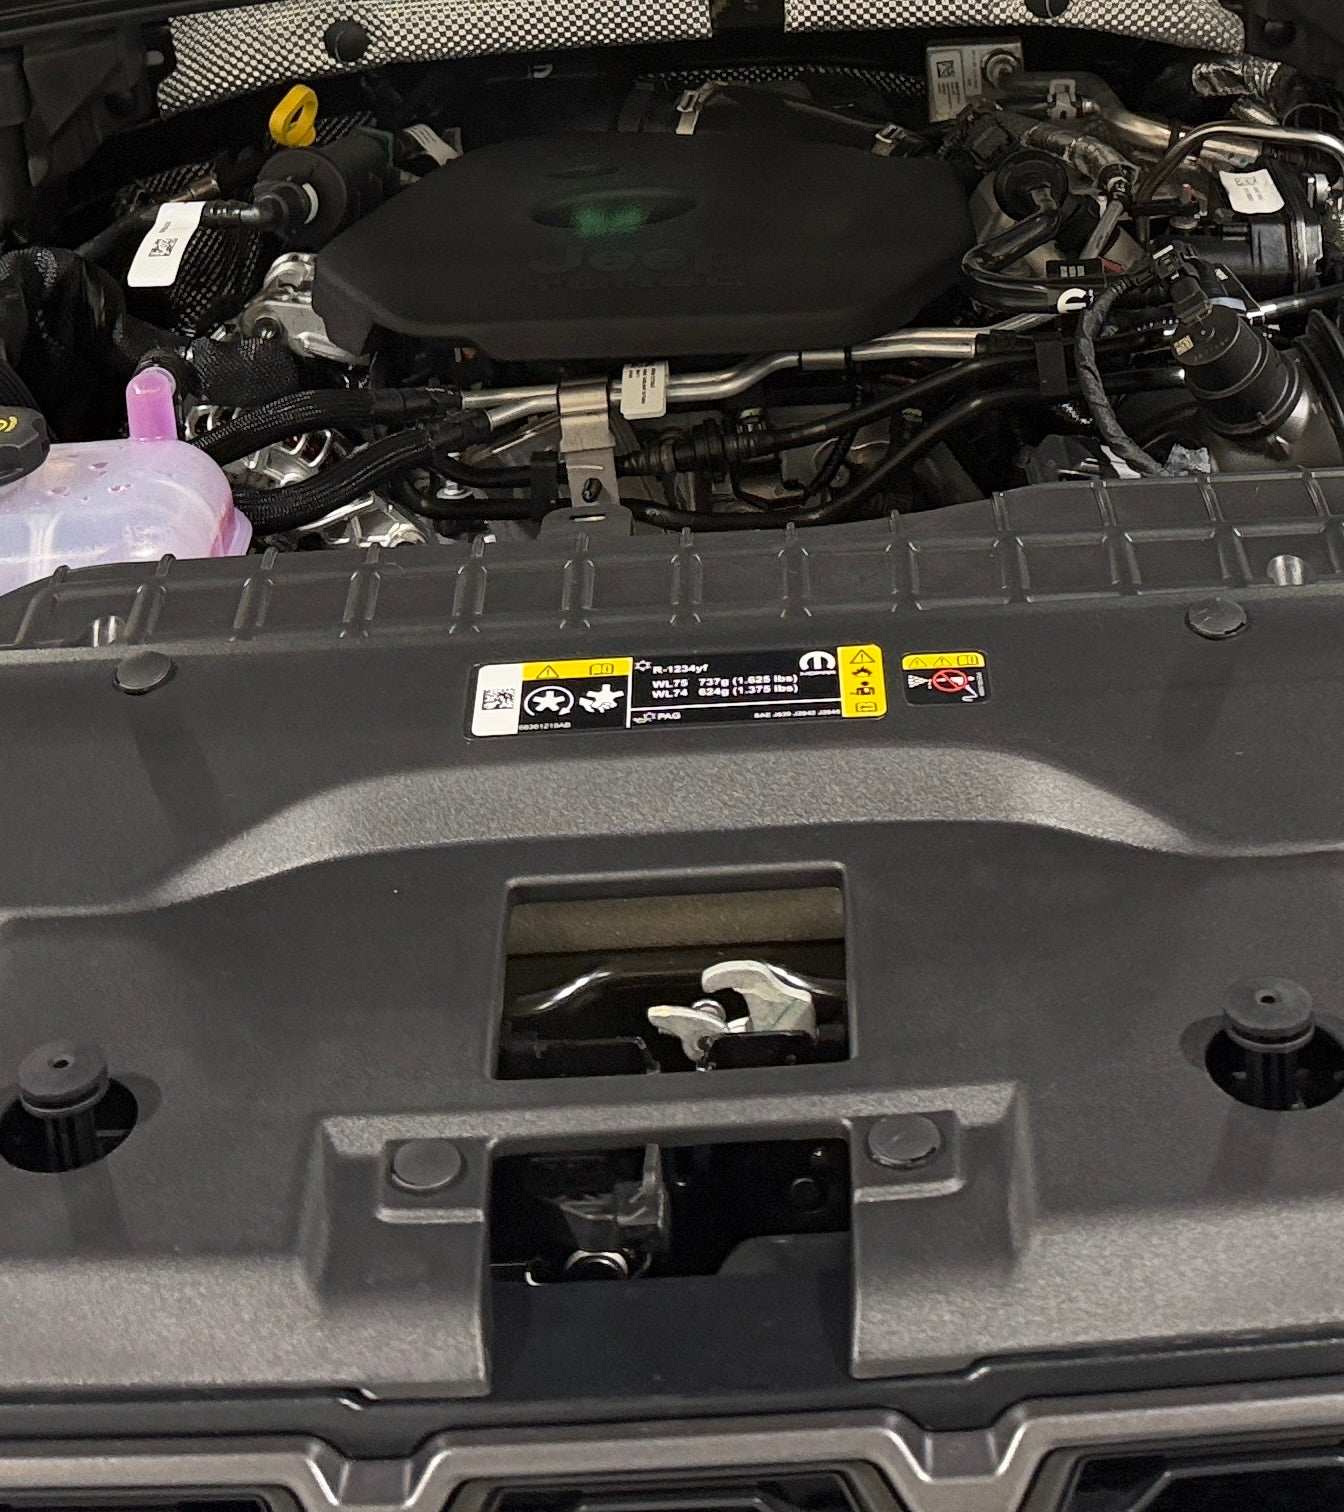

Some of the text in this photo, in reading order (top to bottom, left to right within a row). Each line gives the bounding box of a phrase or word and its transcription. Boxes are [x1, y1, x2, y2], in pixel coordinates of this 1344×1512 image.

[528, 245, 743, 275] Jeep
[652, 663, 709, 675] R-1234yf
[652, 678, 689, 689] WL75
[698, 677, 730, 688] 737g
[773, 674, 799, 684] lbs)
[652, 683, 799, 699] WL74 624g (1.375 lbs)
[657, 711, 682, 720] PAG
